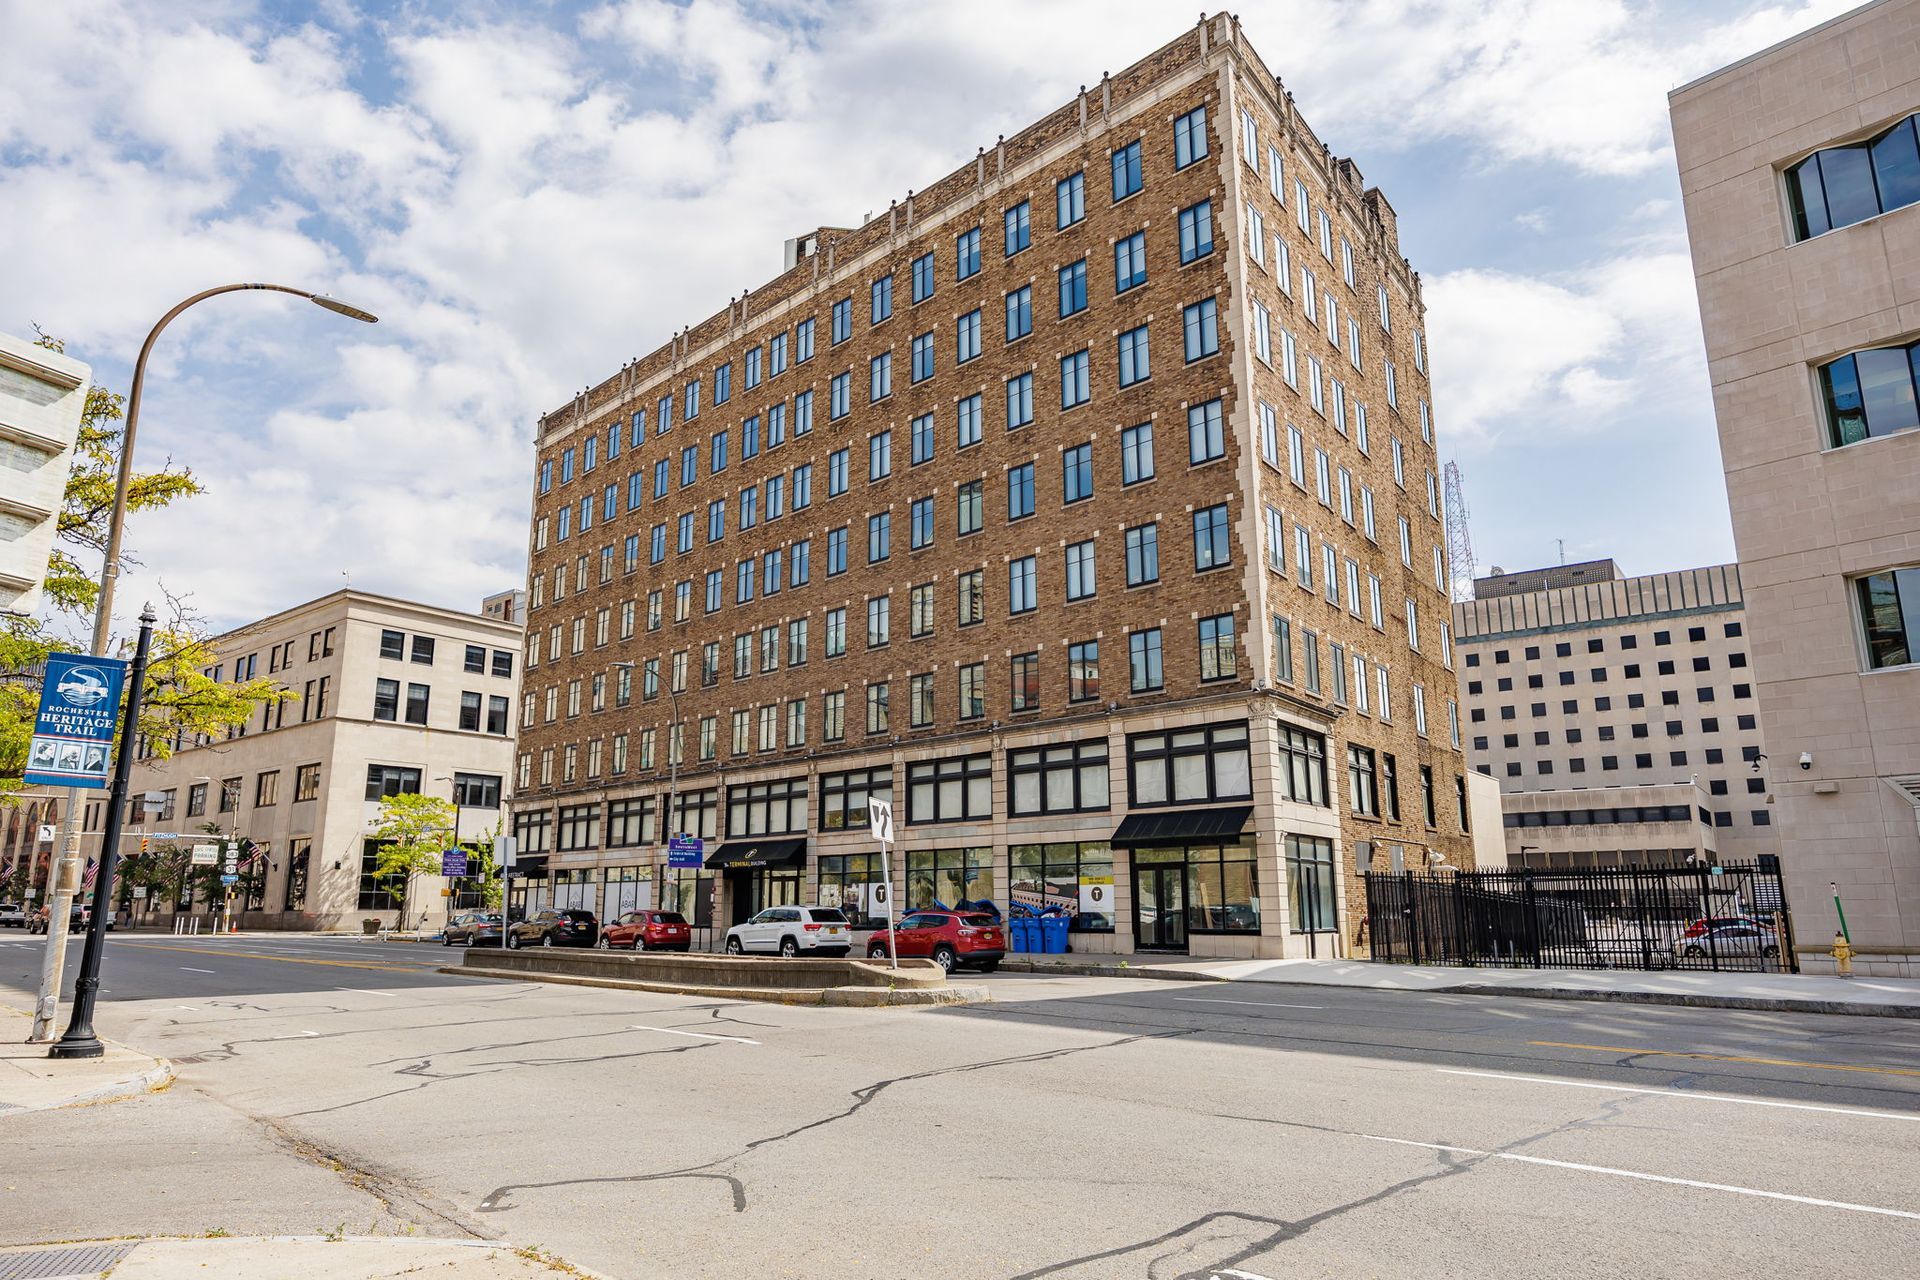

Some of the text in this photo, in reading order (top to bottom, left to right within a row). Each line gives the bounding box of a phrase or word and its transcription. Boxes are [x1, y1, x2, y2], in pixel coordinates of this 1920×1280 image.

[48, 705, 109, 717] ROCHESTER
[41, 712, 114, 729] HERITAGE
[54, 723, 98, 736] TRAIL
